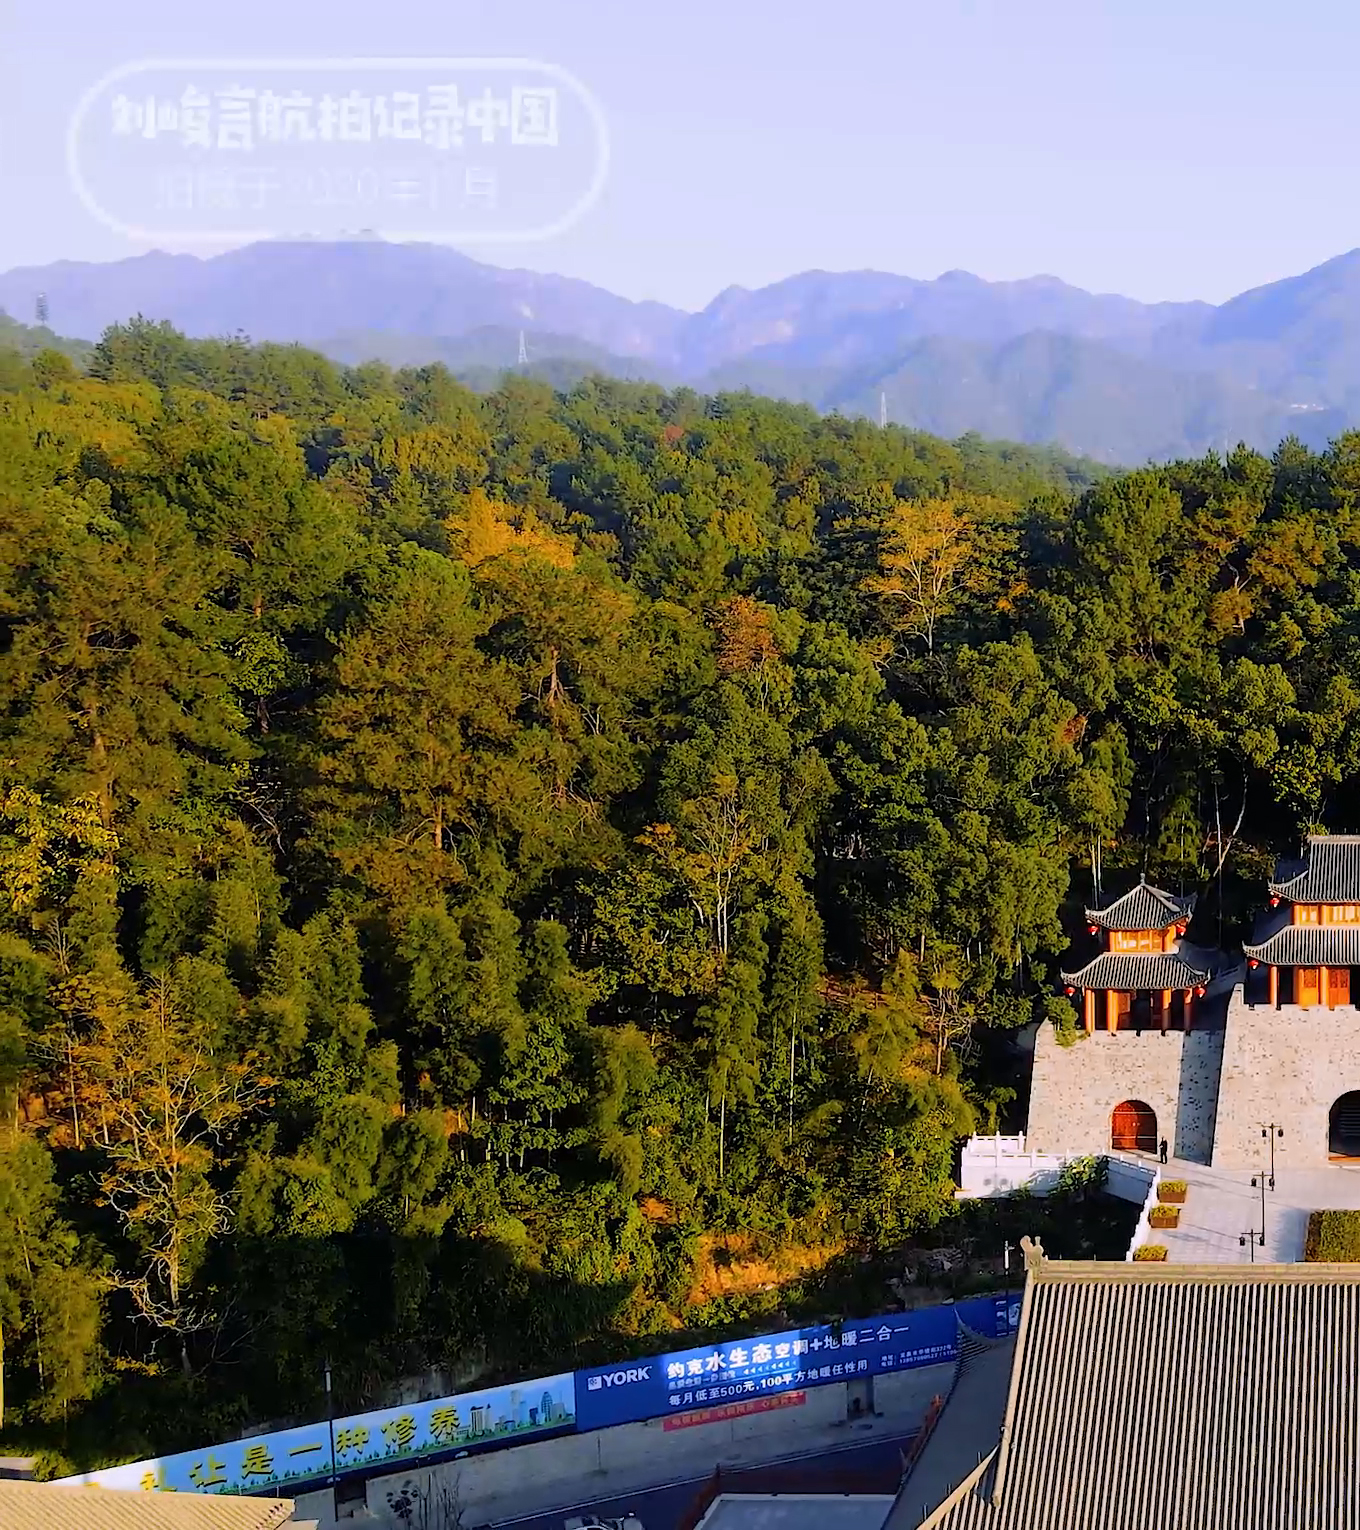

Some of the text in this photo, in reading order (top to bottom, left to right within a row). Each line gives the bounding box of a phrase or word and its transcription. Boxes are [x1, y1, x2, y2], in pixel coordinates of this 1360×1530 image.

[667, 1324, 910, 1379] 约克水生态空调+地暖二合一
[601, 1365, 651, 1387] YORK
